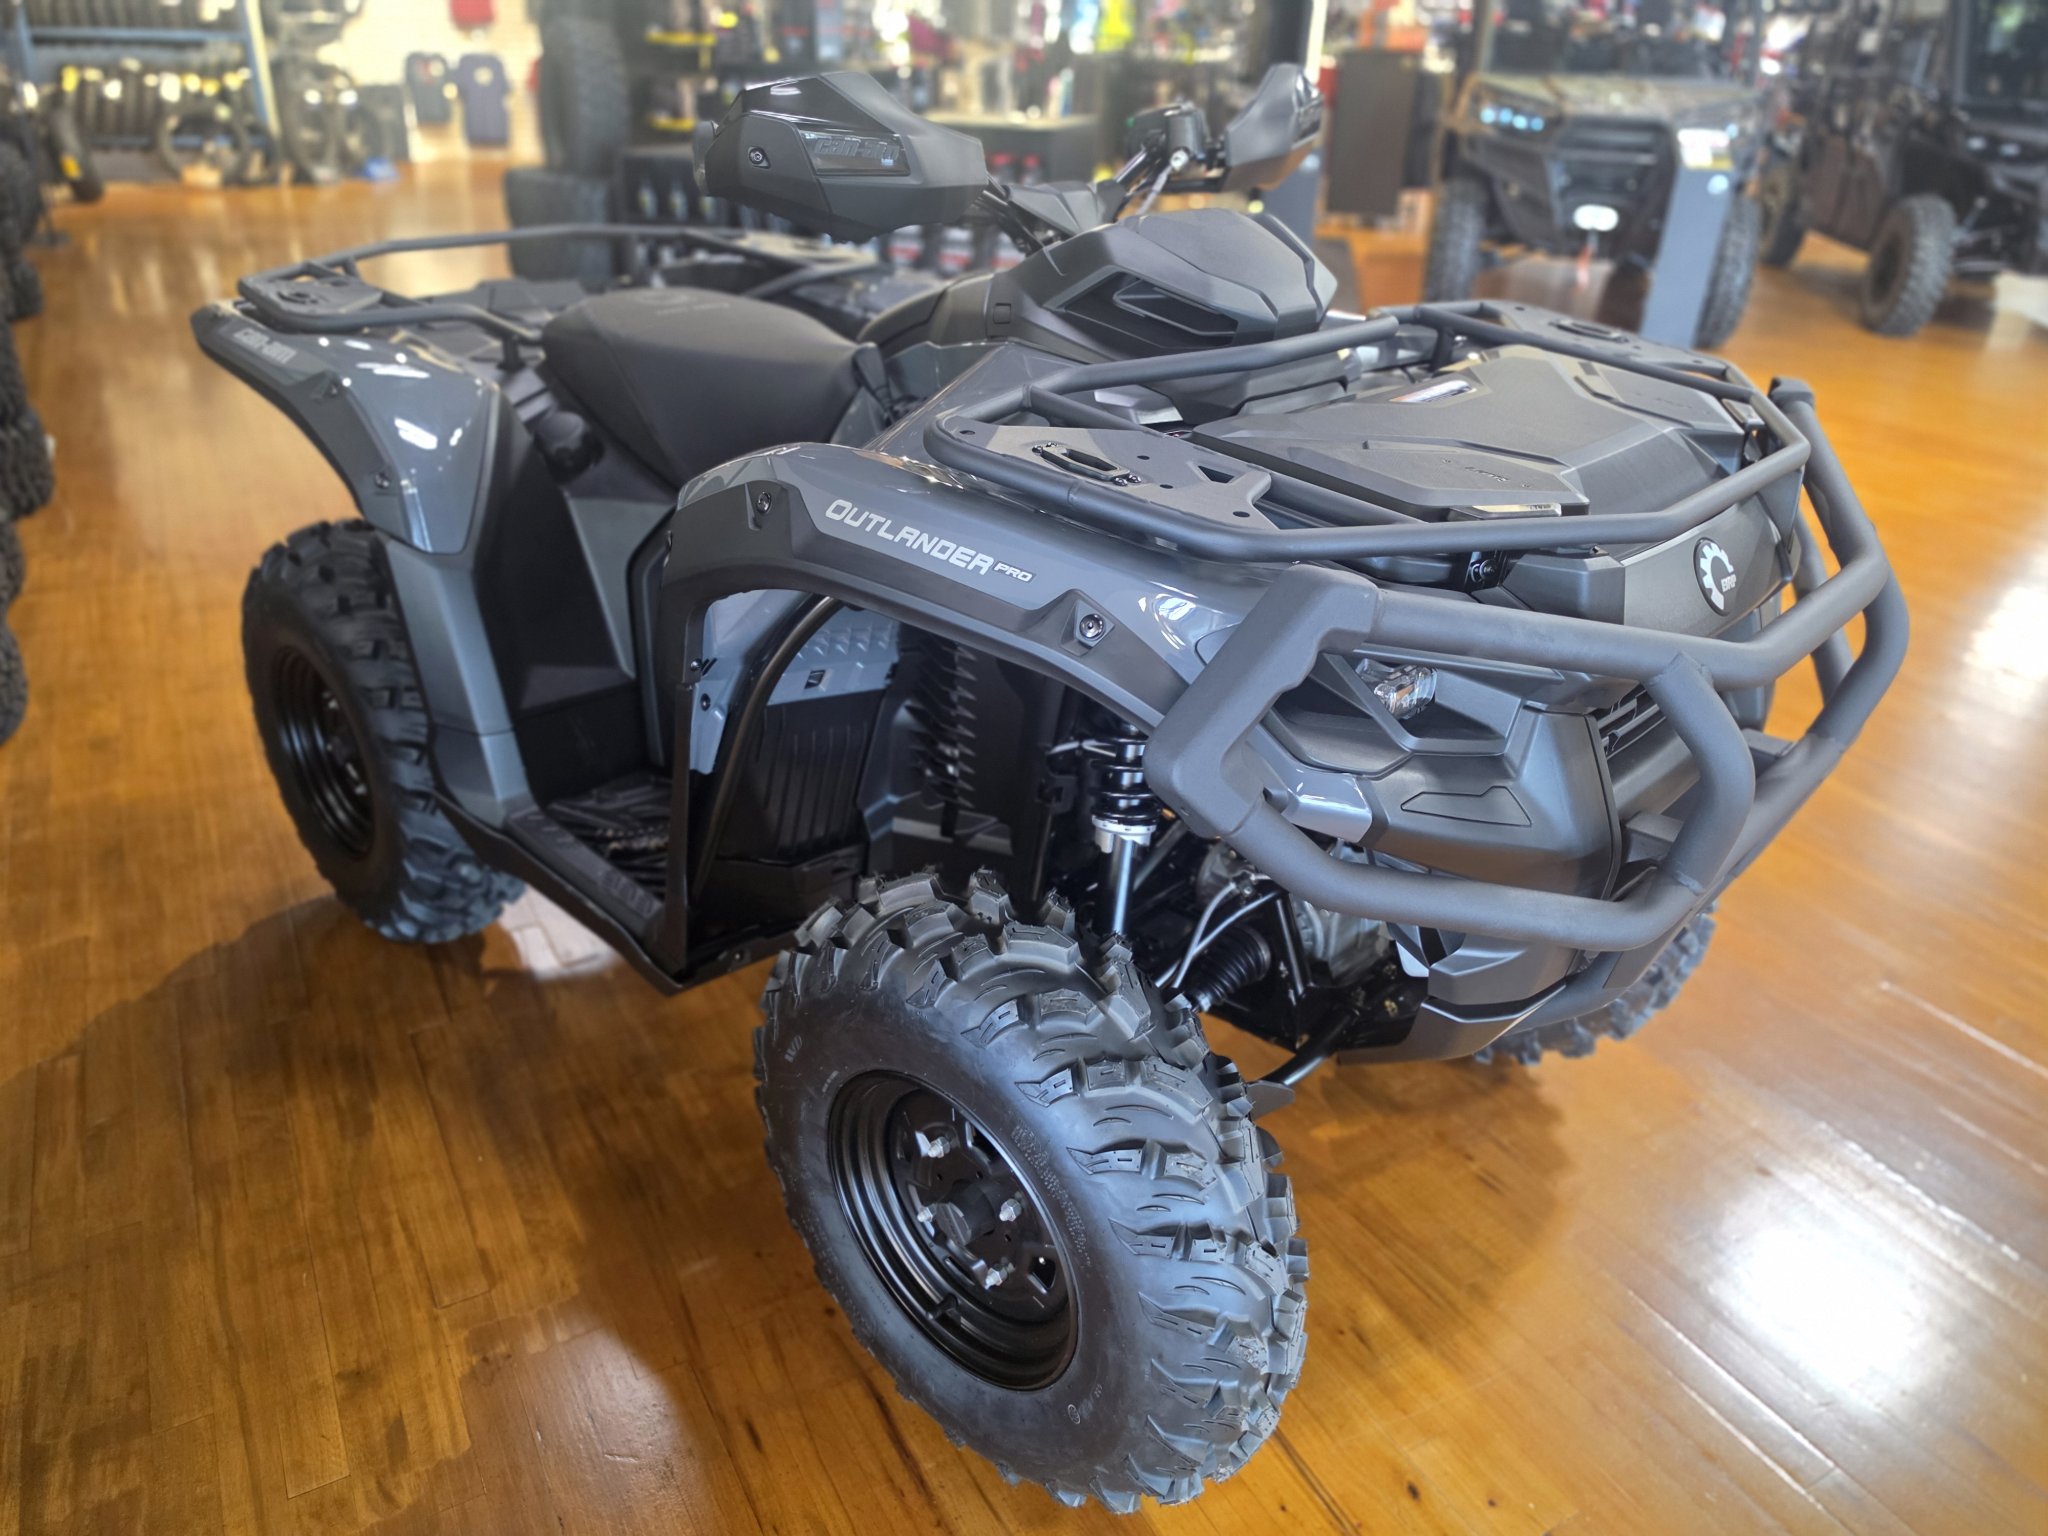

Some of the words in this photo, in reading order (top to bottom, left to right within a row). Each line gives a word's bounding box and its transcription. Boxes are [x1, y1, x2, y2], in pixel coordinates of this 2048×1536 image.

[825, 499, 994, 575] OUTLANDER
[995, 562, 1032, 582] PRO
[1721, 574, 1737, 592] BRP
